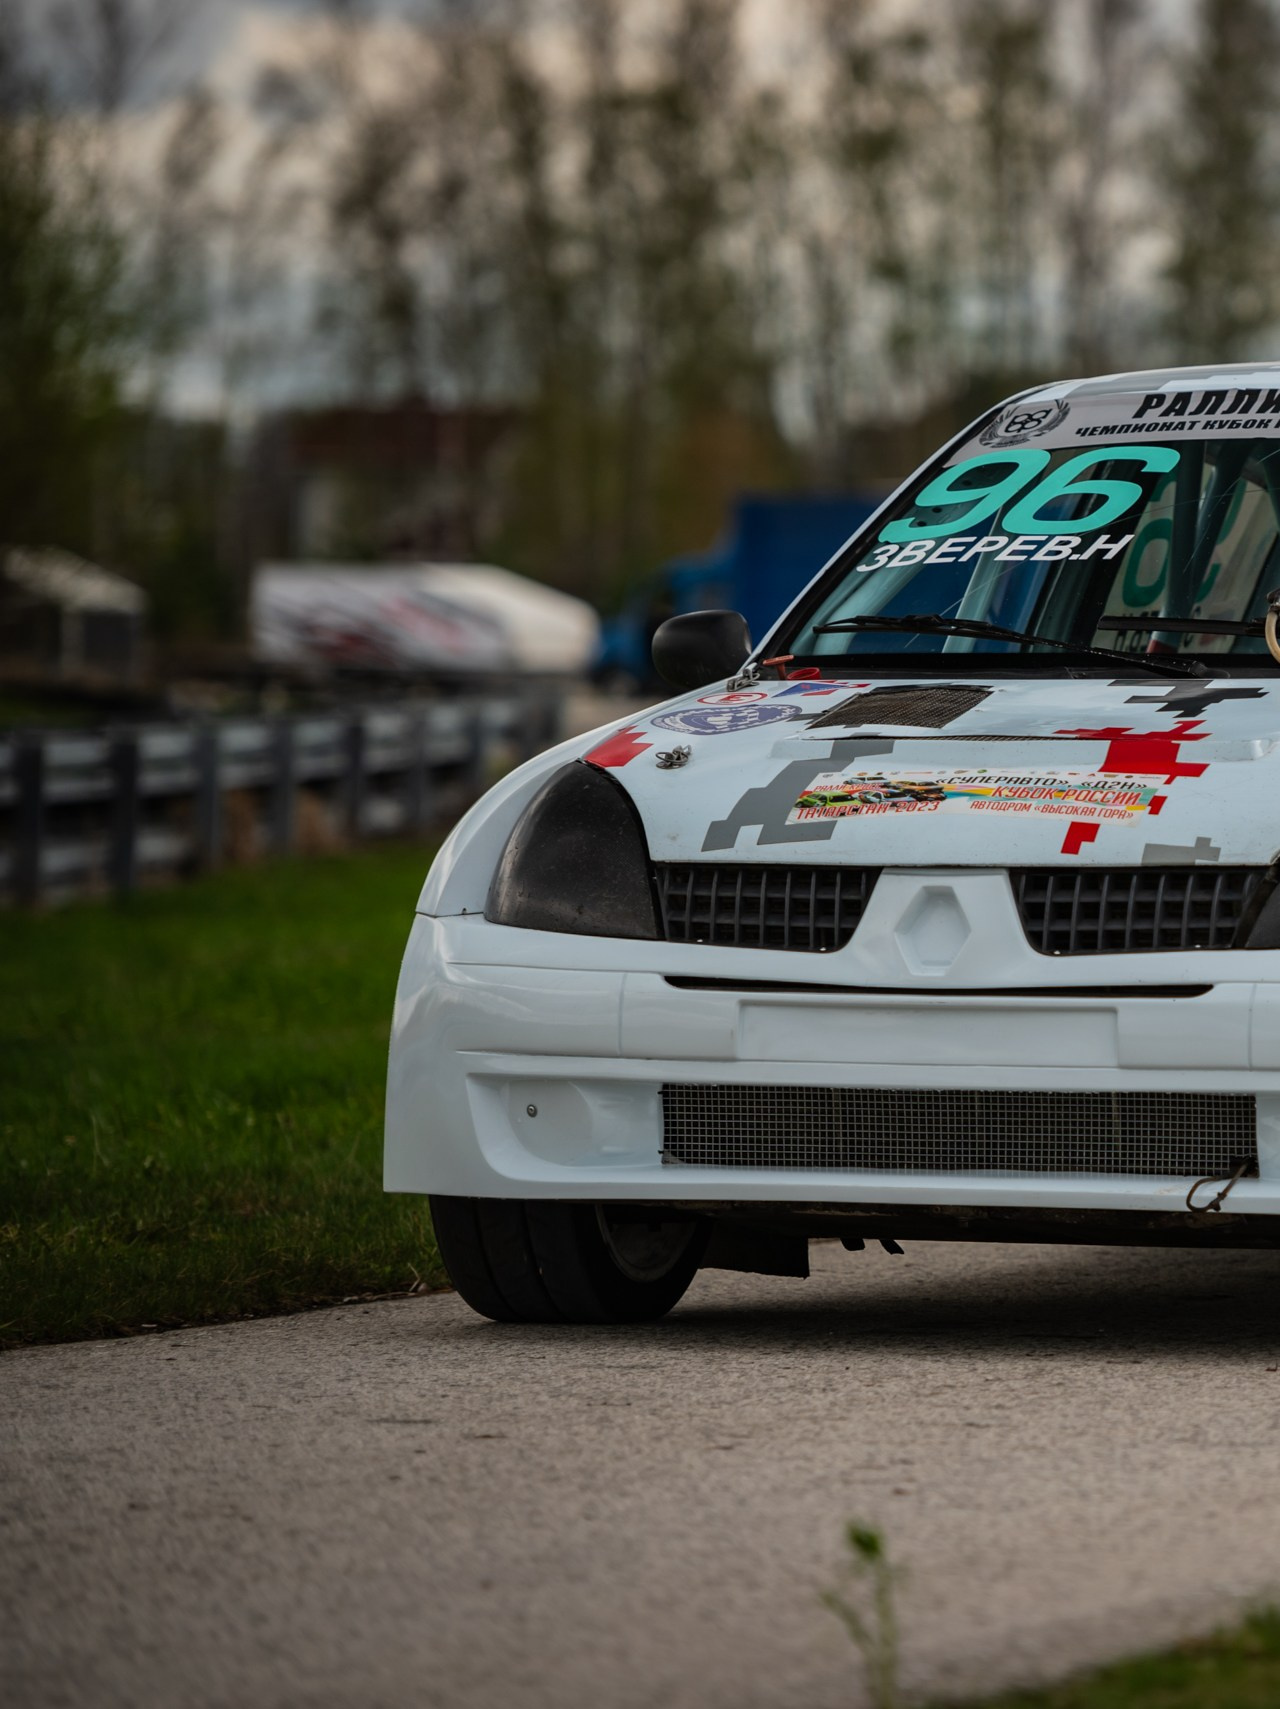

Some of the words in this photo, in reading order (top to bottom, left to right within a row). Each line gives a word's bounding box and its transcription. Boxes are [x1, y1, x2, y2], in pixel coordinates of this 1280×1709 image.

[1075, 420, 1201, 437] ЧЕМПИОНАТ
[1202, 418, 1271, 430] КУБОК
[878, 446, 1181, 543] 96
[856, 534, 1135, 573] ЗВЕРЕВ.Н
[991, 786, 1061, 800] КУБОК
[1060, 788, 1142, 805] РОССИИ
[796, 802, 891, 820] ТАТАРСТАН
[894, 800, 941, 814] 2023
[969, 800, 1032, 812] АВТОДРОМ
[1034, 803, 1096, 817] «ВЫСОКАЯ
[1097, 808, 1135, 820] ГОРА»
